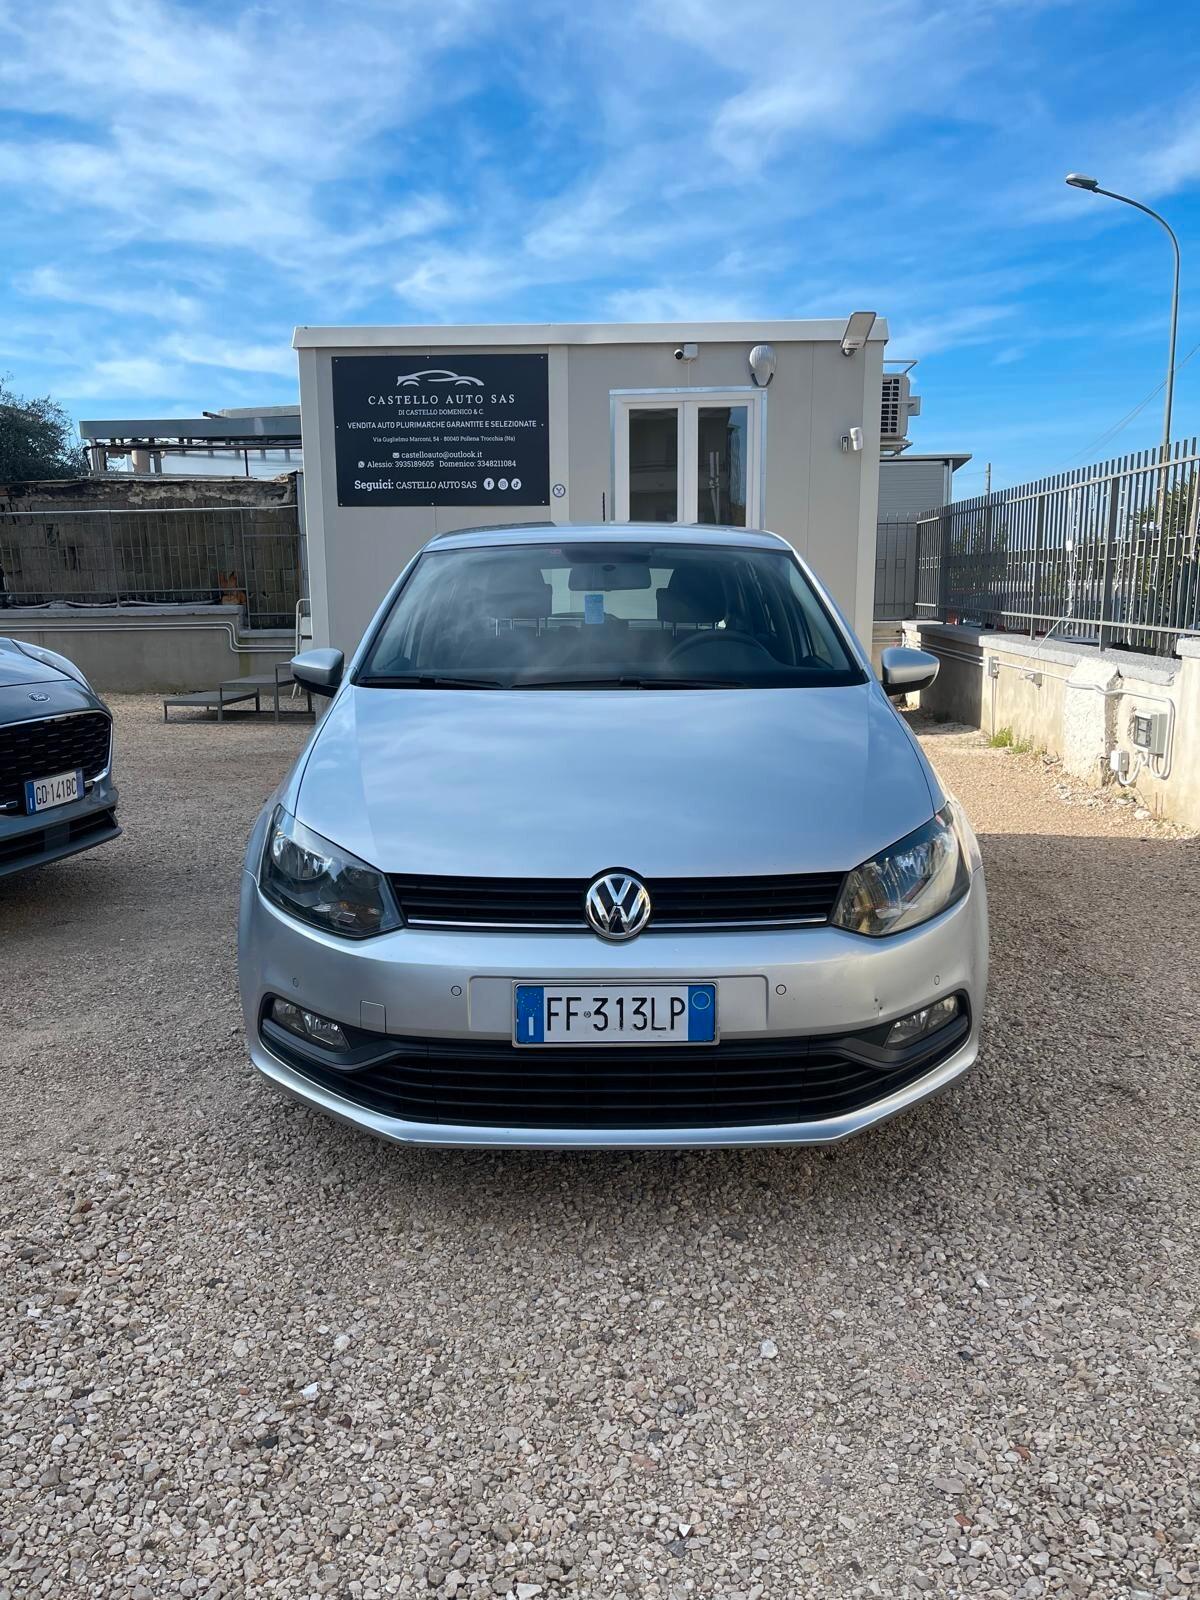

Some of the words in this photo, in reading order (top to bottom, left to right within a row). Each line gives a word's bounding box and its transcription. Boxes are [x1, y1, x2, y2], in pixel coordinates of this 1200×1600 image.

[368, 395, 439, 405] CASTELLO
[445, 394, 483, 404] AUTO
[490, 394, 515, 404] SAS
[347, 421, 376, 429] VENDITA
[378, 421, 395, 429] AUTO
[396, 420, 445, 429] PLURIMARCHE
[446, 420, 484, 428] GARANTITE
[485, 420, 490, 428] E
[490, 420, 537, 428] SELEZIONATE
[401, 451, 482, 460] castelloauto@outlook.it
[367, 460, 393, 468] Alessio:
[394, 460, 434, 468] 3935189605
[439, 460, 475, 468] Domenico:
[354, 478, 394, 491] Seguici:
[396, 481, 437, 489] CASTELLO
[437, 481, 460, 489] AUTO
[461, 481, 477, 489] SAS
[546, 996, 582, 1031] FF
[592, 996, 686, 1031] 313LP
